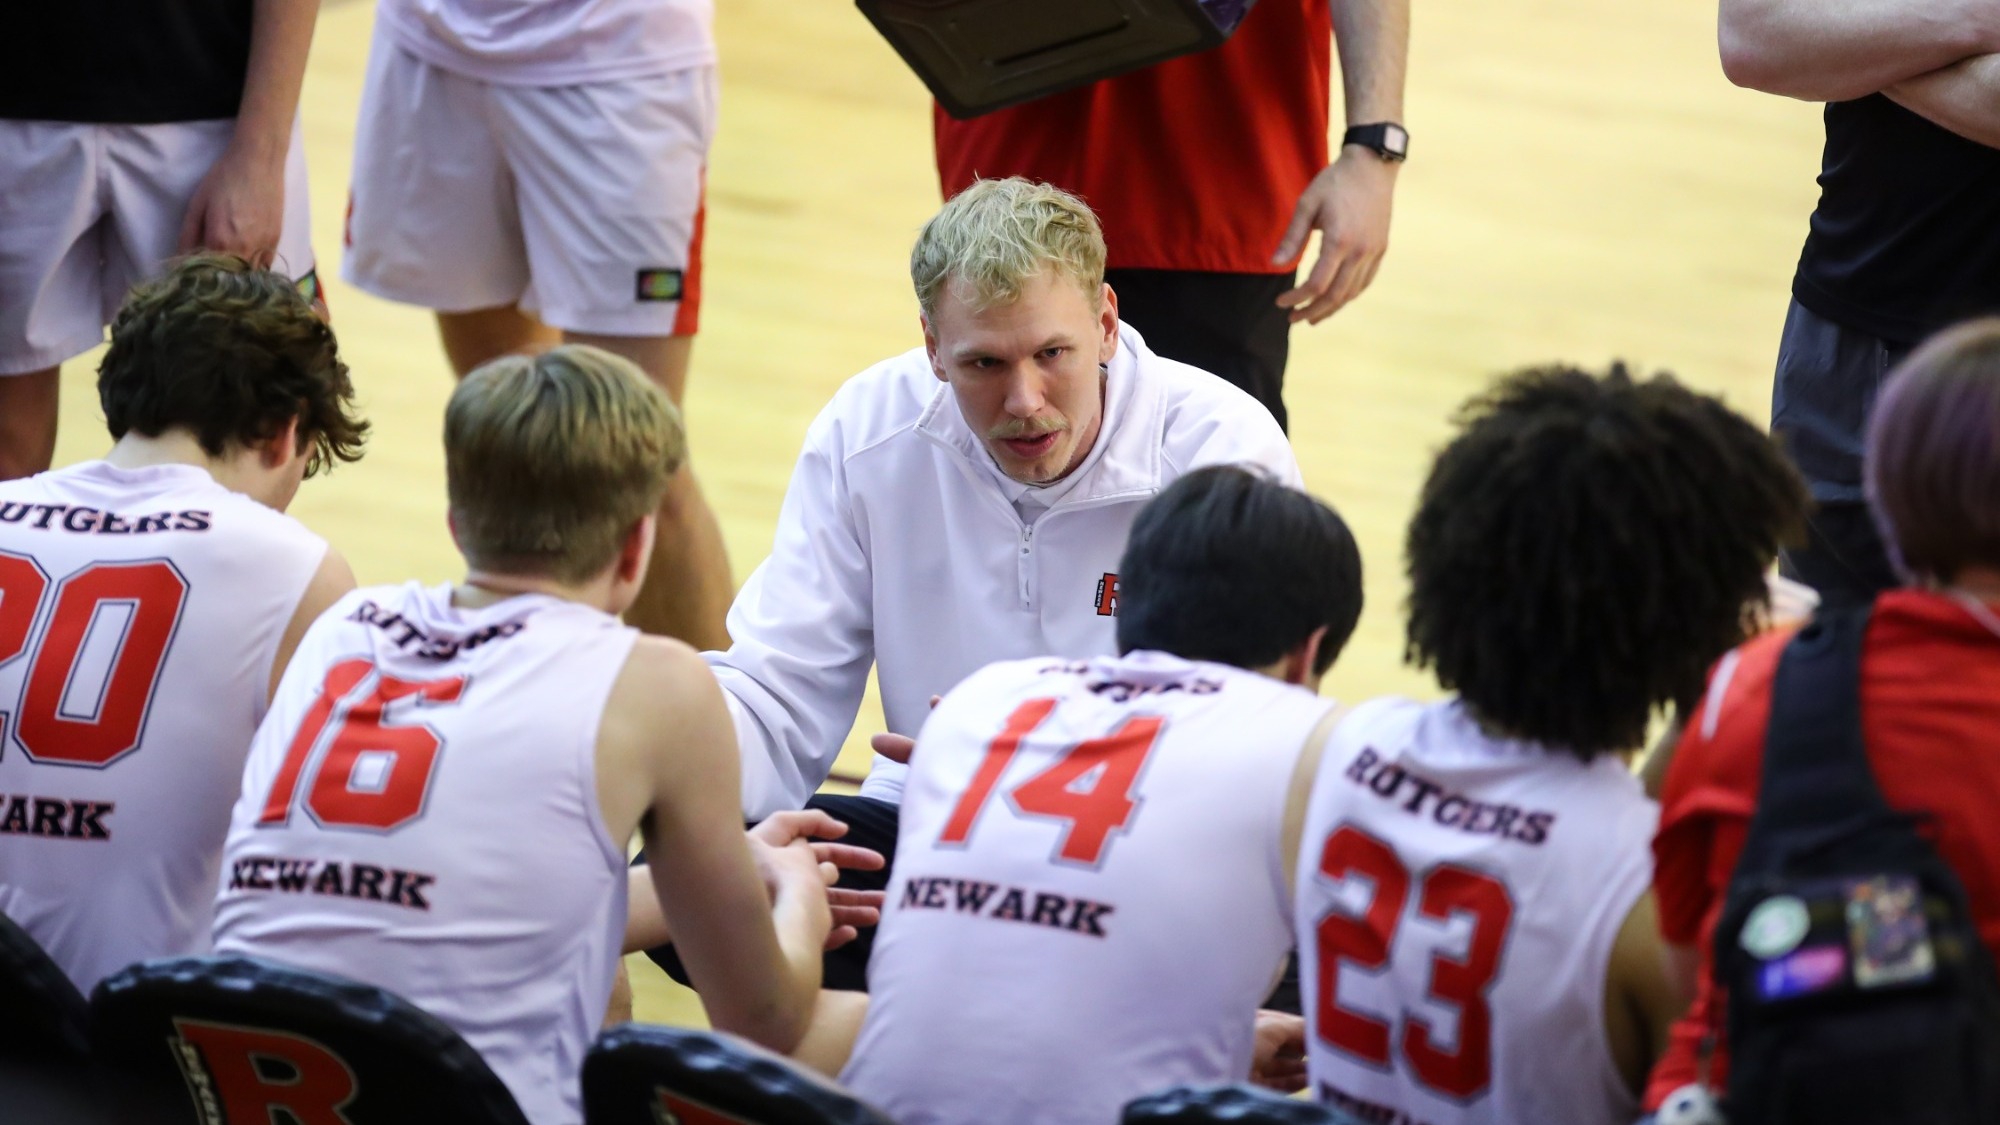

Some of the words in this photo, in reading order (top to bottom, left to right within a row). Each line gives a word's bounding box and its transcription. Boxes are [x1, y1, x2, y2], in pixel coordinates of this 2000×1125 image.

[0, 500, 213, 536] UTGERS
[254, 655, 472, 837] 16
[932, 695, 1168, 873] 14
[0, 793, 115, 841] ARK
[1345, 744, 1558, 847] RUTGERS
[229, 856, 436, 911] NEWARK
[898, 873, 1115, 938] NEWARK
[1312, 822, 1520, 1106] 23
